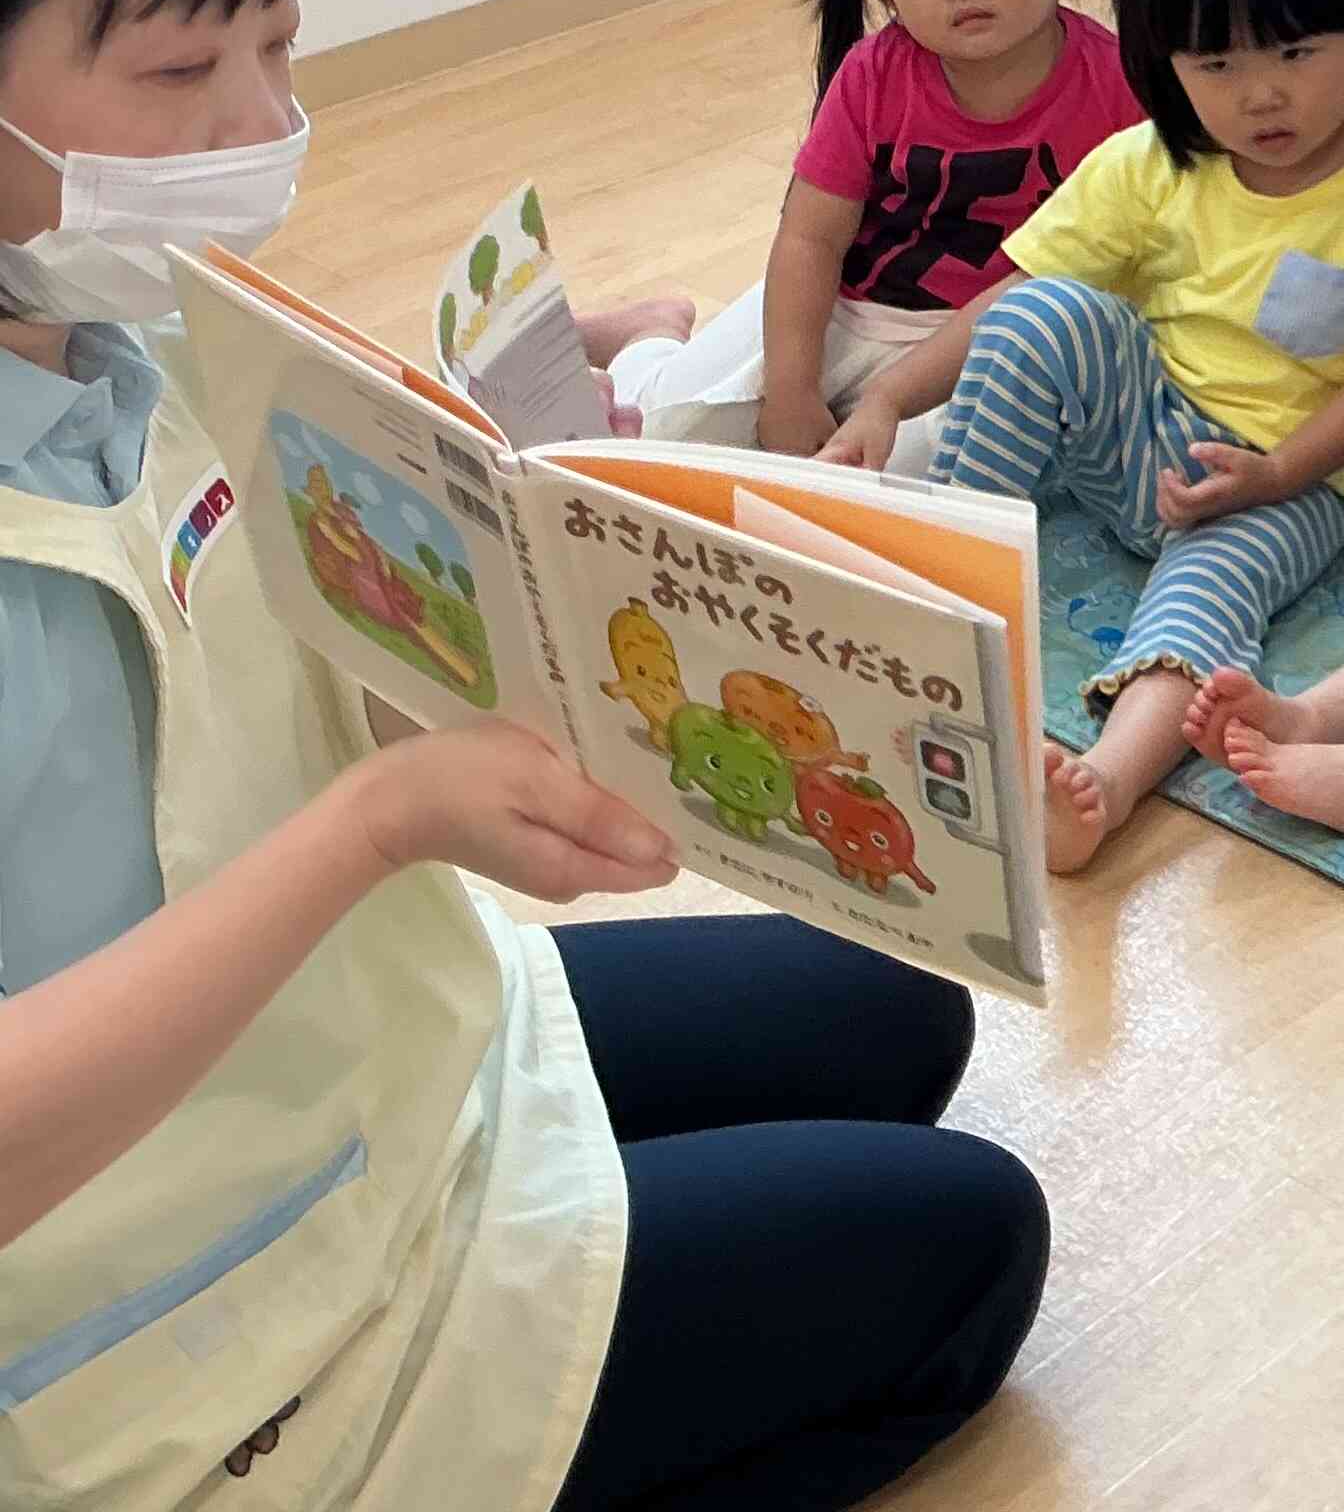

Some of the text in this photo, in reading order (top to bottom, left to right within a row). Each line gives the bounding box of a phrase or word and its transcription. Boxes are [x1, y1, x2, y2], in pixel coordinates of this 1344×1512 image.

[563, 497, 793, 605] おさんぽの
[650, 569, 963, 712] おやくそくだもの
